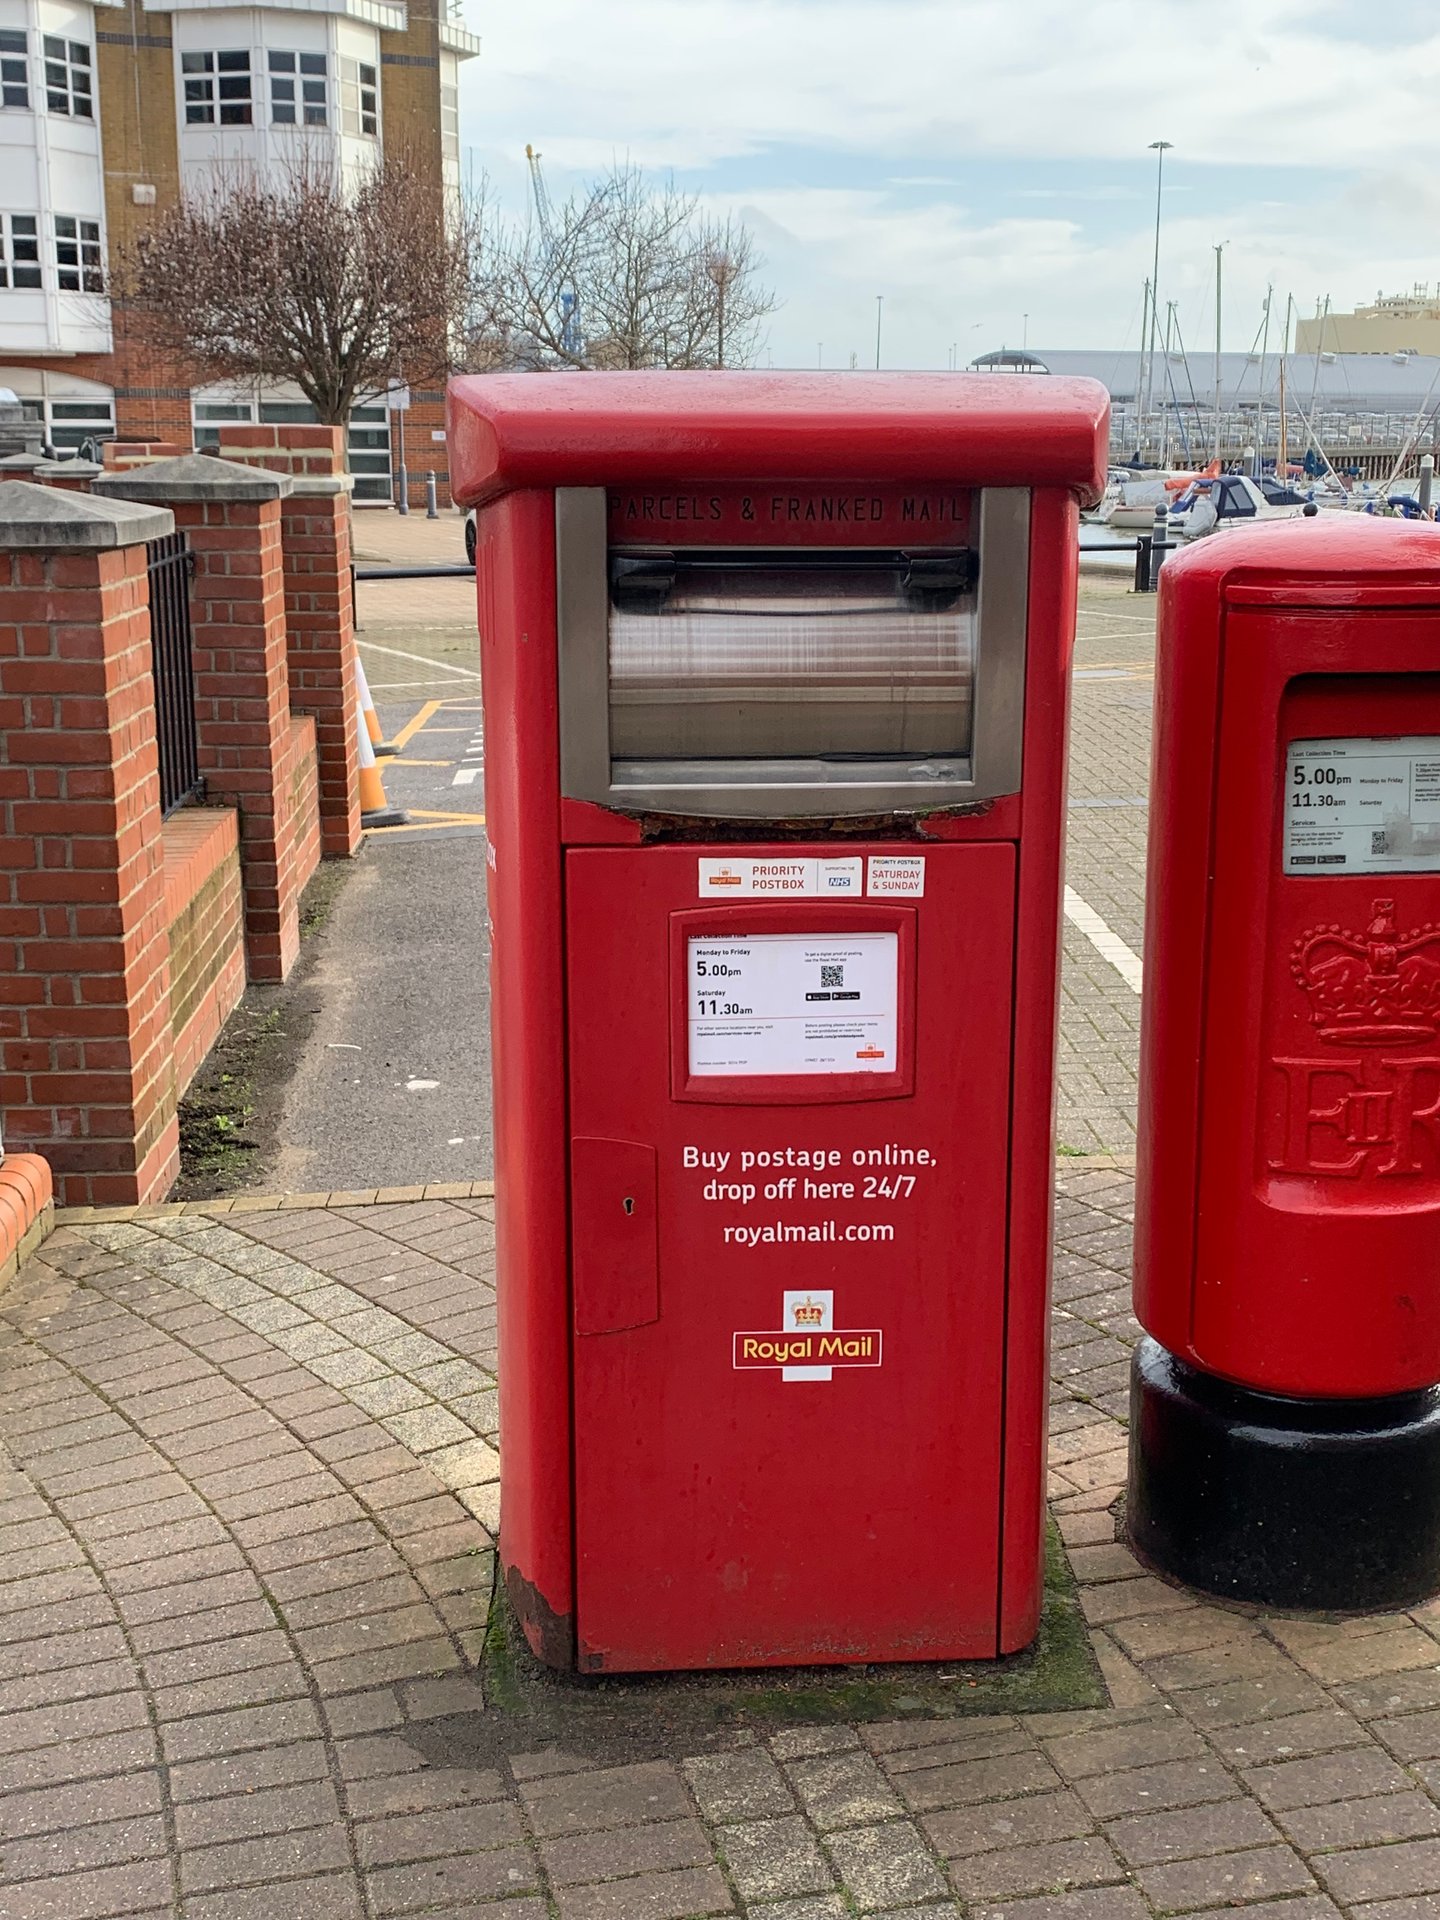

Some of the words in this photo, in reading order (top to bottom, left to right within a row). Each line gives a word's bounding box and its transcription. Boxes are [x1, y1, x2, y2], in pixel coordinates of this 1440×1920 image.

[607, 496, 722, 520] PARCELS
[741, 498, 755, 521] &
[771, 498, 883, 521] FRANKED
[902, 498, 963, 521] MAIL
[1293, 765, 1352, 785] 5.00pm
[1292, 792, 1346, 807] 11.30am
[752, 865, 805, 876] PRIORITY
[872, 870, 920, 879] SATURDAY
[752, 879, 805, 890] POSTBOX
[829, 878, 850, 887] NHS
[872, 881, 879, 890] &
[882, 881, 920, 890] SUNDAY
[730, 948, 751, 956] Friday
[696, 960, 742, 977] 5.00pm
[697, 999, 753, 1015] 11.30am
[683, 1146, 731, 1172] Buy
[741, 1147, 841, 1172] postage
[852, 1143, 937, 1168] online,
[703, 1178, 756, 1205] drop
[763, 1177, 797, 1200] off
[803, 1177, 855, 1199] here
[862, 1174, 916, 1200] 24/7
[723, 1220, 895, 1248] royalmail.com
[743, 1337, 812, 1363] Royal
[817, 1336, 872, 1357] Mail
